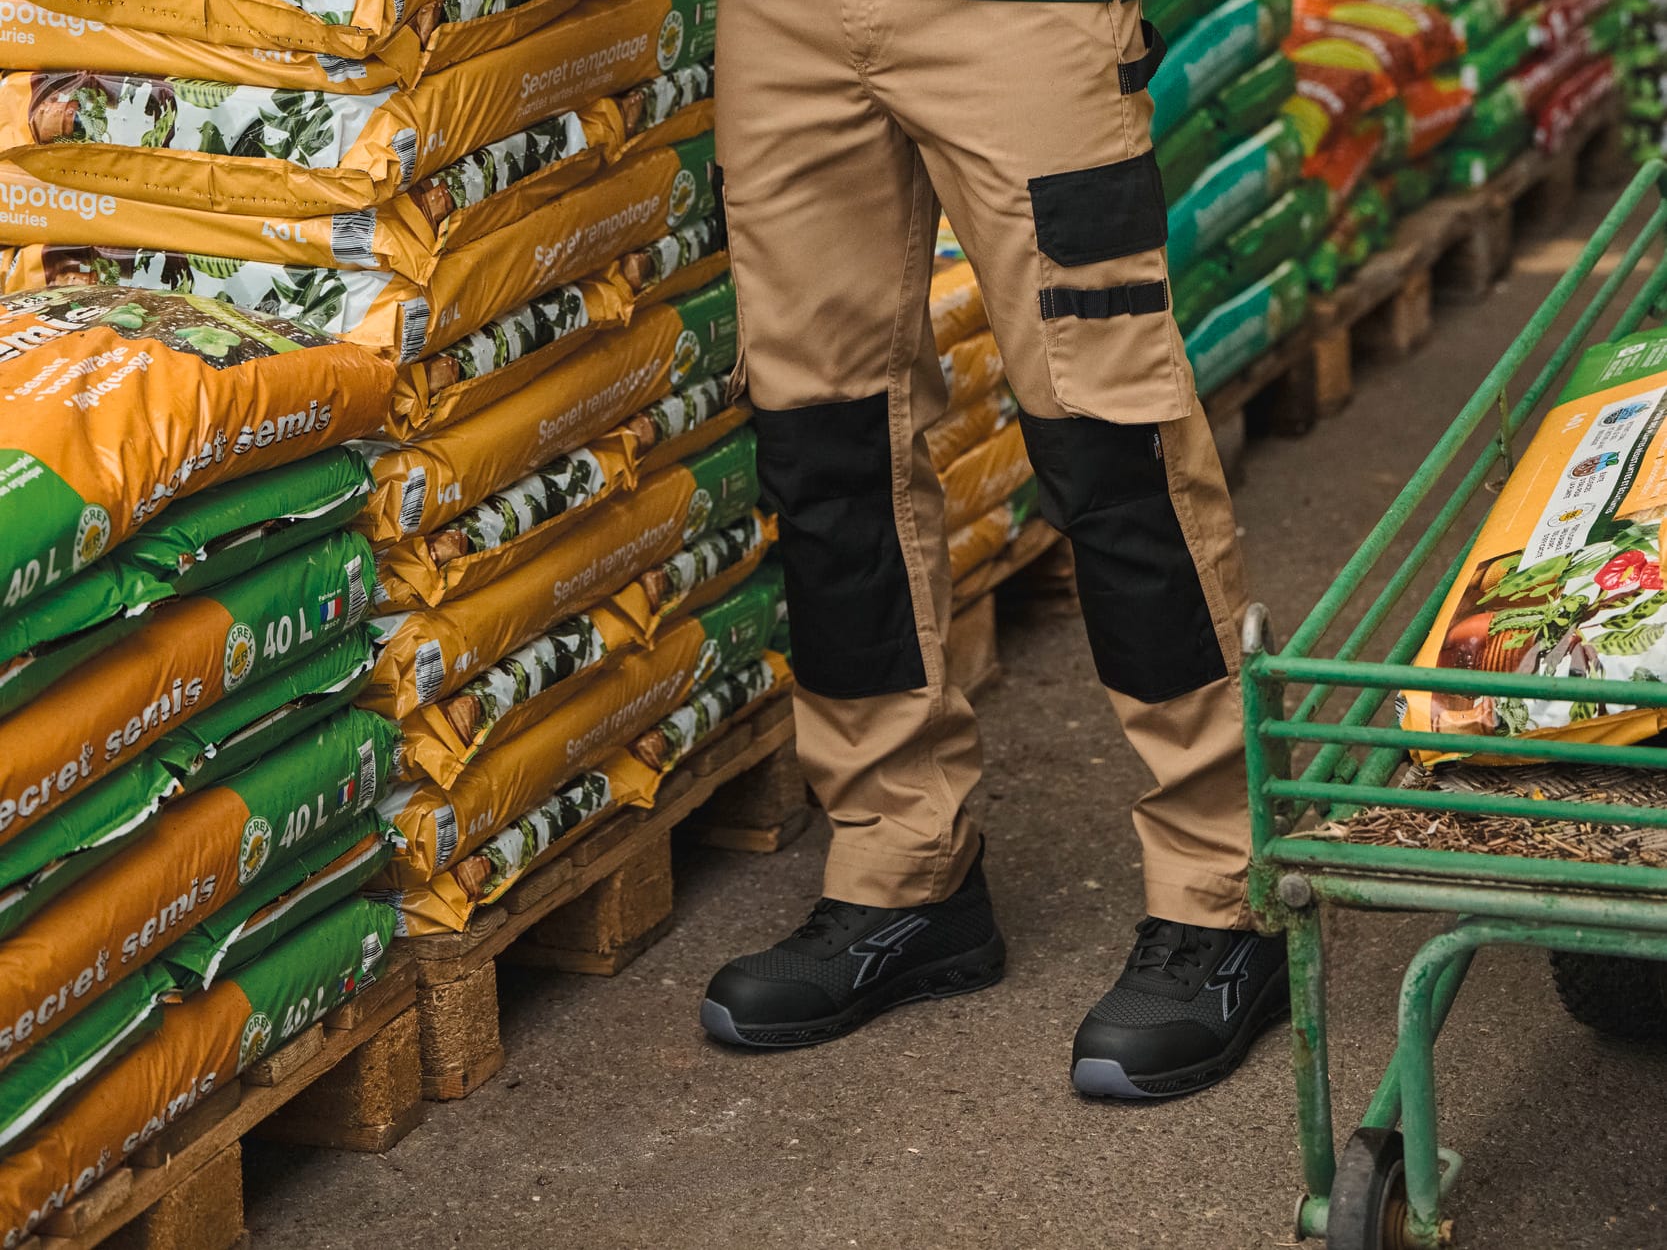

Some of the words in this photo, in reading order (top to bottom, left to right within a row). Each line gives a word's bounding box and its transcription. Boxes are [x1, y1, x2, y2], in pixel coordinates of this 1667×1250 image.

[520, 59, 569, 99] Secret
[569, 33, 648, 78] rempotage
[584, 195, 660, 243] rempotage
[233, 400, 331, 454] semis
[539, 401, 586, 445] Secret
[553, 561, 599, 606] Secret
[263, 615, 293, 660] 40
[299, 607, 313, 645] L
[105, 677, 202, 761] semis
[314, 793, 329, 830] L
[0, 947, 109, 1052] secret
[121, 874, 216, 963] semis
[312, 985, 328, 1021] L
